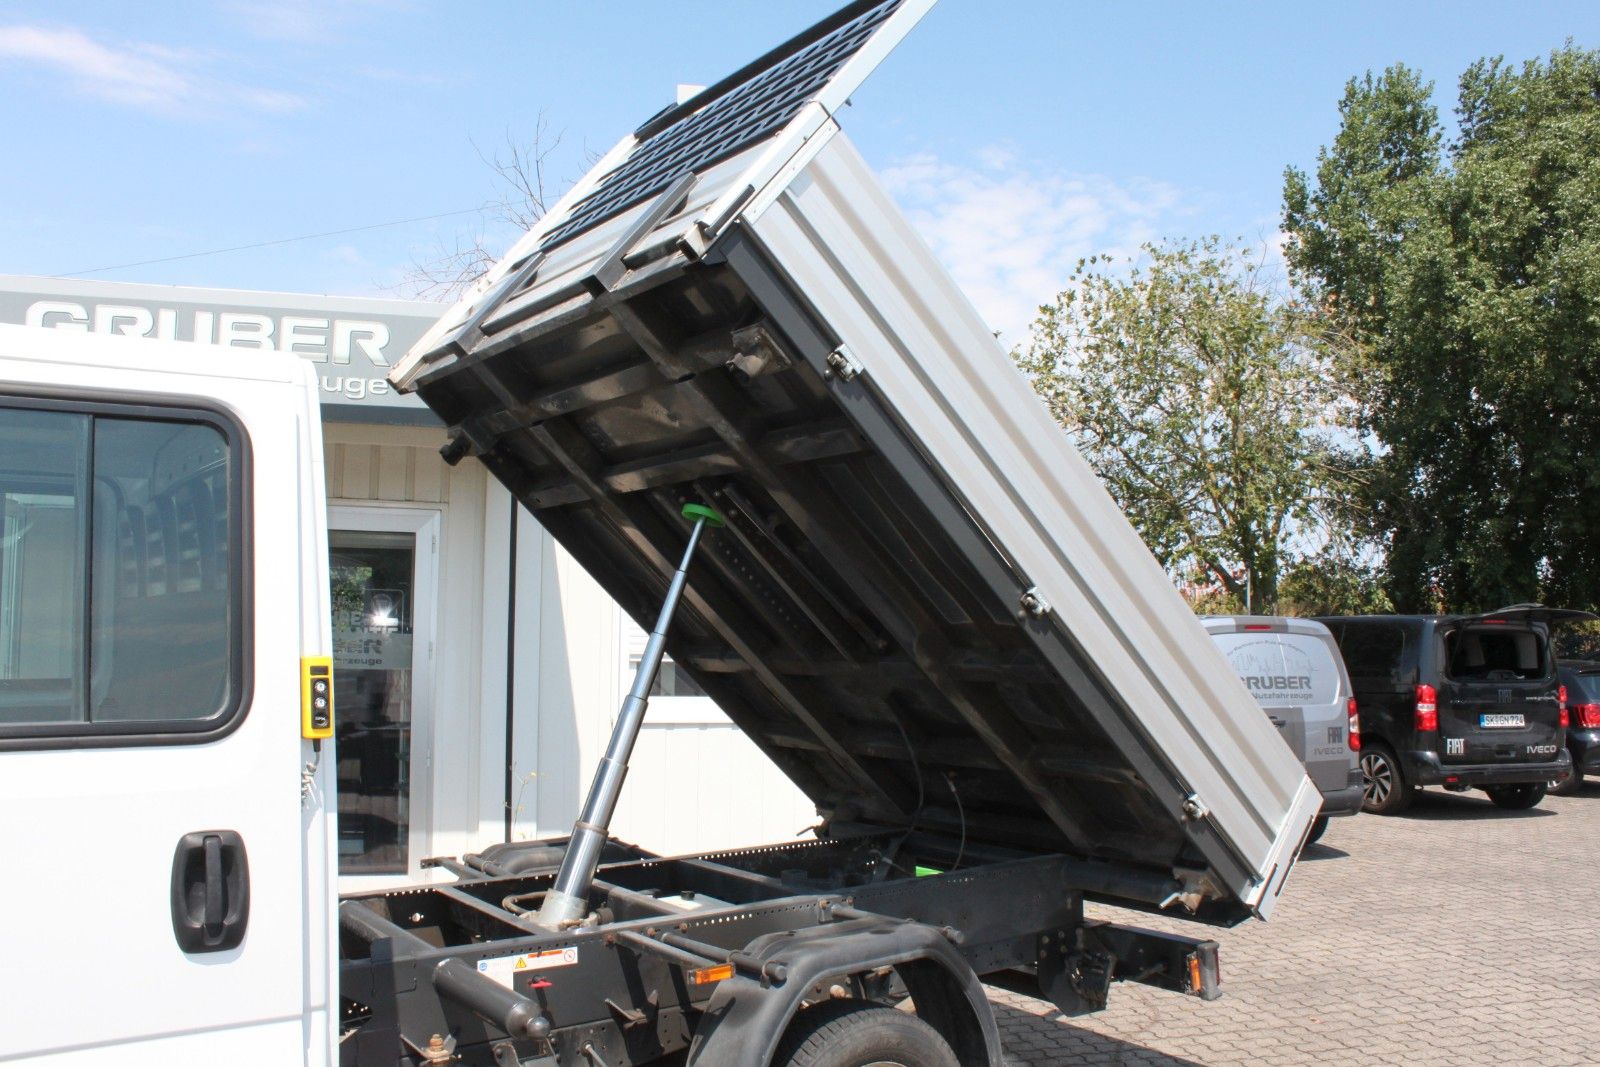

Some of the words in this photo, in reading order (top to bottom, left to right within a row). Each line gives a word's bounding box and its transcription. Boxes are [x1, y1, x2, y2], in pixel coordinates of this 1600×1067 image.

[1240, 676, 1312, 690] RUBER
[1314, 747, 1344, 755] IVECO
[1447, 738, 1464, 754] FIAT
[1526, 745, 1557, 754] IVECO
